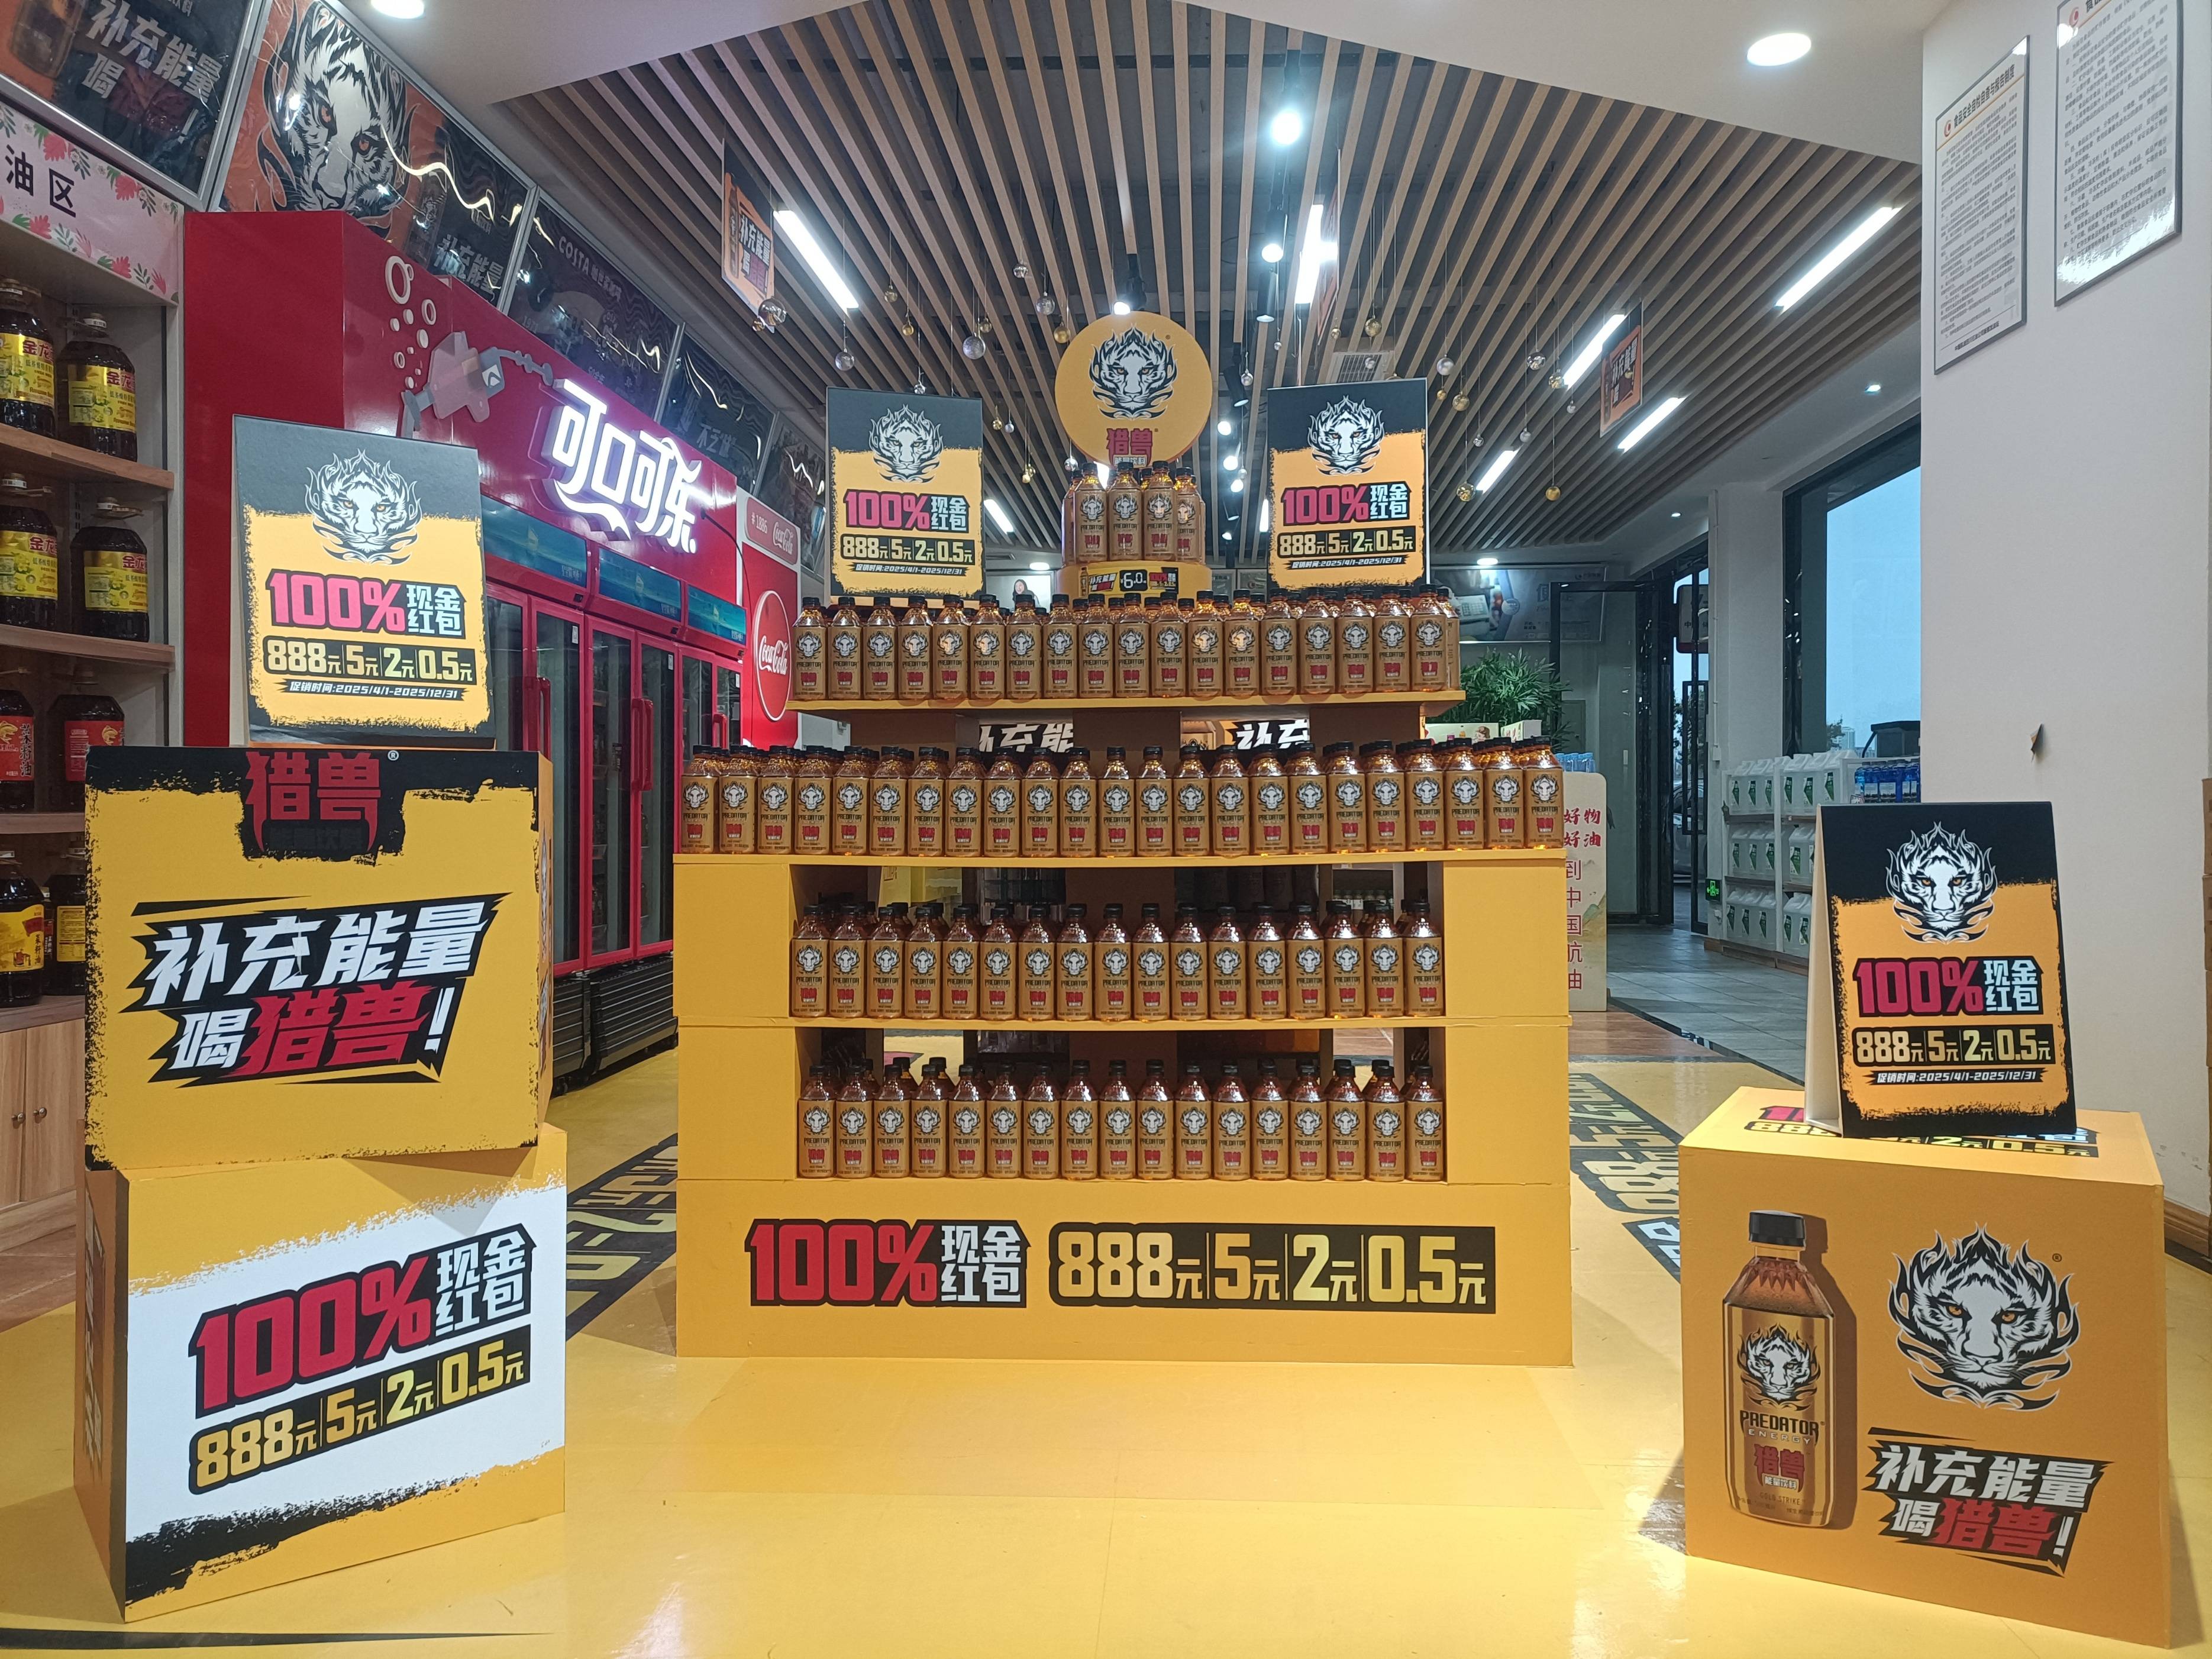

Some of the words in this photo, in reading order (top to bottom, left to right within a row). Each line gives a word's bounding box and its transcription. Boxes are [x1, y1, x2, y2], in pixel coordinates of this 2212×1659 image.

[85, 0, 223, 103] 补充能量
[5, 144, 76, 218] 油区
[558, 236, 589, 276] COSTA
[740, 214, 771, 267] 补充能量
[550, 379, 702, 554] 可口可乐
[1106, 428, 1154, 468] 猎兽
[845, 491, 930, 530] 100%
[931, 496, 967, 514] 现金
[1283, 485, 1369, 525] 100%
[1370, 483, 1408, 502] 现金
[1370, 501, 1408, 519] 红包
[931, 513, 967, 531] 红包
[842, 535, 889, 560] 888元
[891, 538, 912, 561] 5元
[915, 540, 935, 561] 2元
[938, 541, 973, 563] 0.5元
[1279, 533, 1326, 557] 888元
[1328, 531, 1349, 554] 5元
[1352, 531, 1373, 553] 2元
[1376, 528, 1414, 551] 0.5元
[122, 555, 147, 573] 金龙
[268, 571, 406, 633] 100%
[406, 584, 461, 612] 现金
[406, 609, 463, 636] 红包
[266, 639, 341, 674] 888元
[345, 644, 379, 677] 5元
[382, 647, 415, 679] 2元
[418, 649, 473, 683] 0.5元
[289, 680, 458, 699] 促销时间:2025/4/1-2025/12/31
[246, 750, 382, 853] 猎兽
[1564, 808, 1601, 825] 好物
[1564, 831, 1601, 848] 好油
[144, 900, 489, 1008] 补充能量
[1983, 958, 2039, 986] 现金
[1856, 960, 1984, 1015] 100%
[1985, 986, 2039, 1012] 红包
[1855, 1030, 1924, 1063] 888元
[1927, 1029, 1959, 1063] 5元
[1962, 1029, 1995, 1062] 2元
[1997, 1028, 2052, 1061] 0.5元
[1877, 1070, 2037, 1084] 促销时间:2025/4/1-2025/12/31
[435, 1230, 526, 1293] 现金
[750, 1223, 937, 1302] 100%
[941, 1224, 1022, 1264] 现金
[941, 1263, 1021, 1303] 红包
[1058, 1230, 1203, 1300] 888元
[1214, 1231, 1281, 1302] 5元
[1292, 1234, 1358, 1303] 2元
[1368, 1235, 1488, 1306] 0.5元
[434, 1276, 525, 1338] 红包
[195, 1254, 433, 1410] 100%
[195, 1408, 318, 1489] 888元
[324, 1387, 377, 1444] 5元
[387, 1368, 434, 1422] 2元
[441, 1339, 524, 1405] 0.5元
[1739, 1409, 1819, 1446] PREDATOR
[1748, 1428, 1811, 1445] ENERGY
[1753, 1443, 1806, 1493] 猎兽
[1874, 1442, 2100, 1510] 补充能量
[1778, 1495, 1801, 1506] STRIKE
